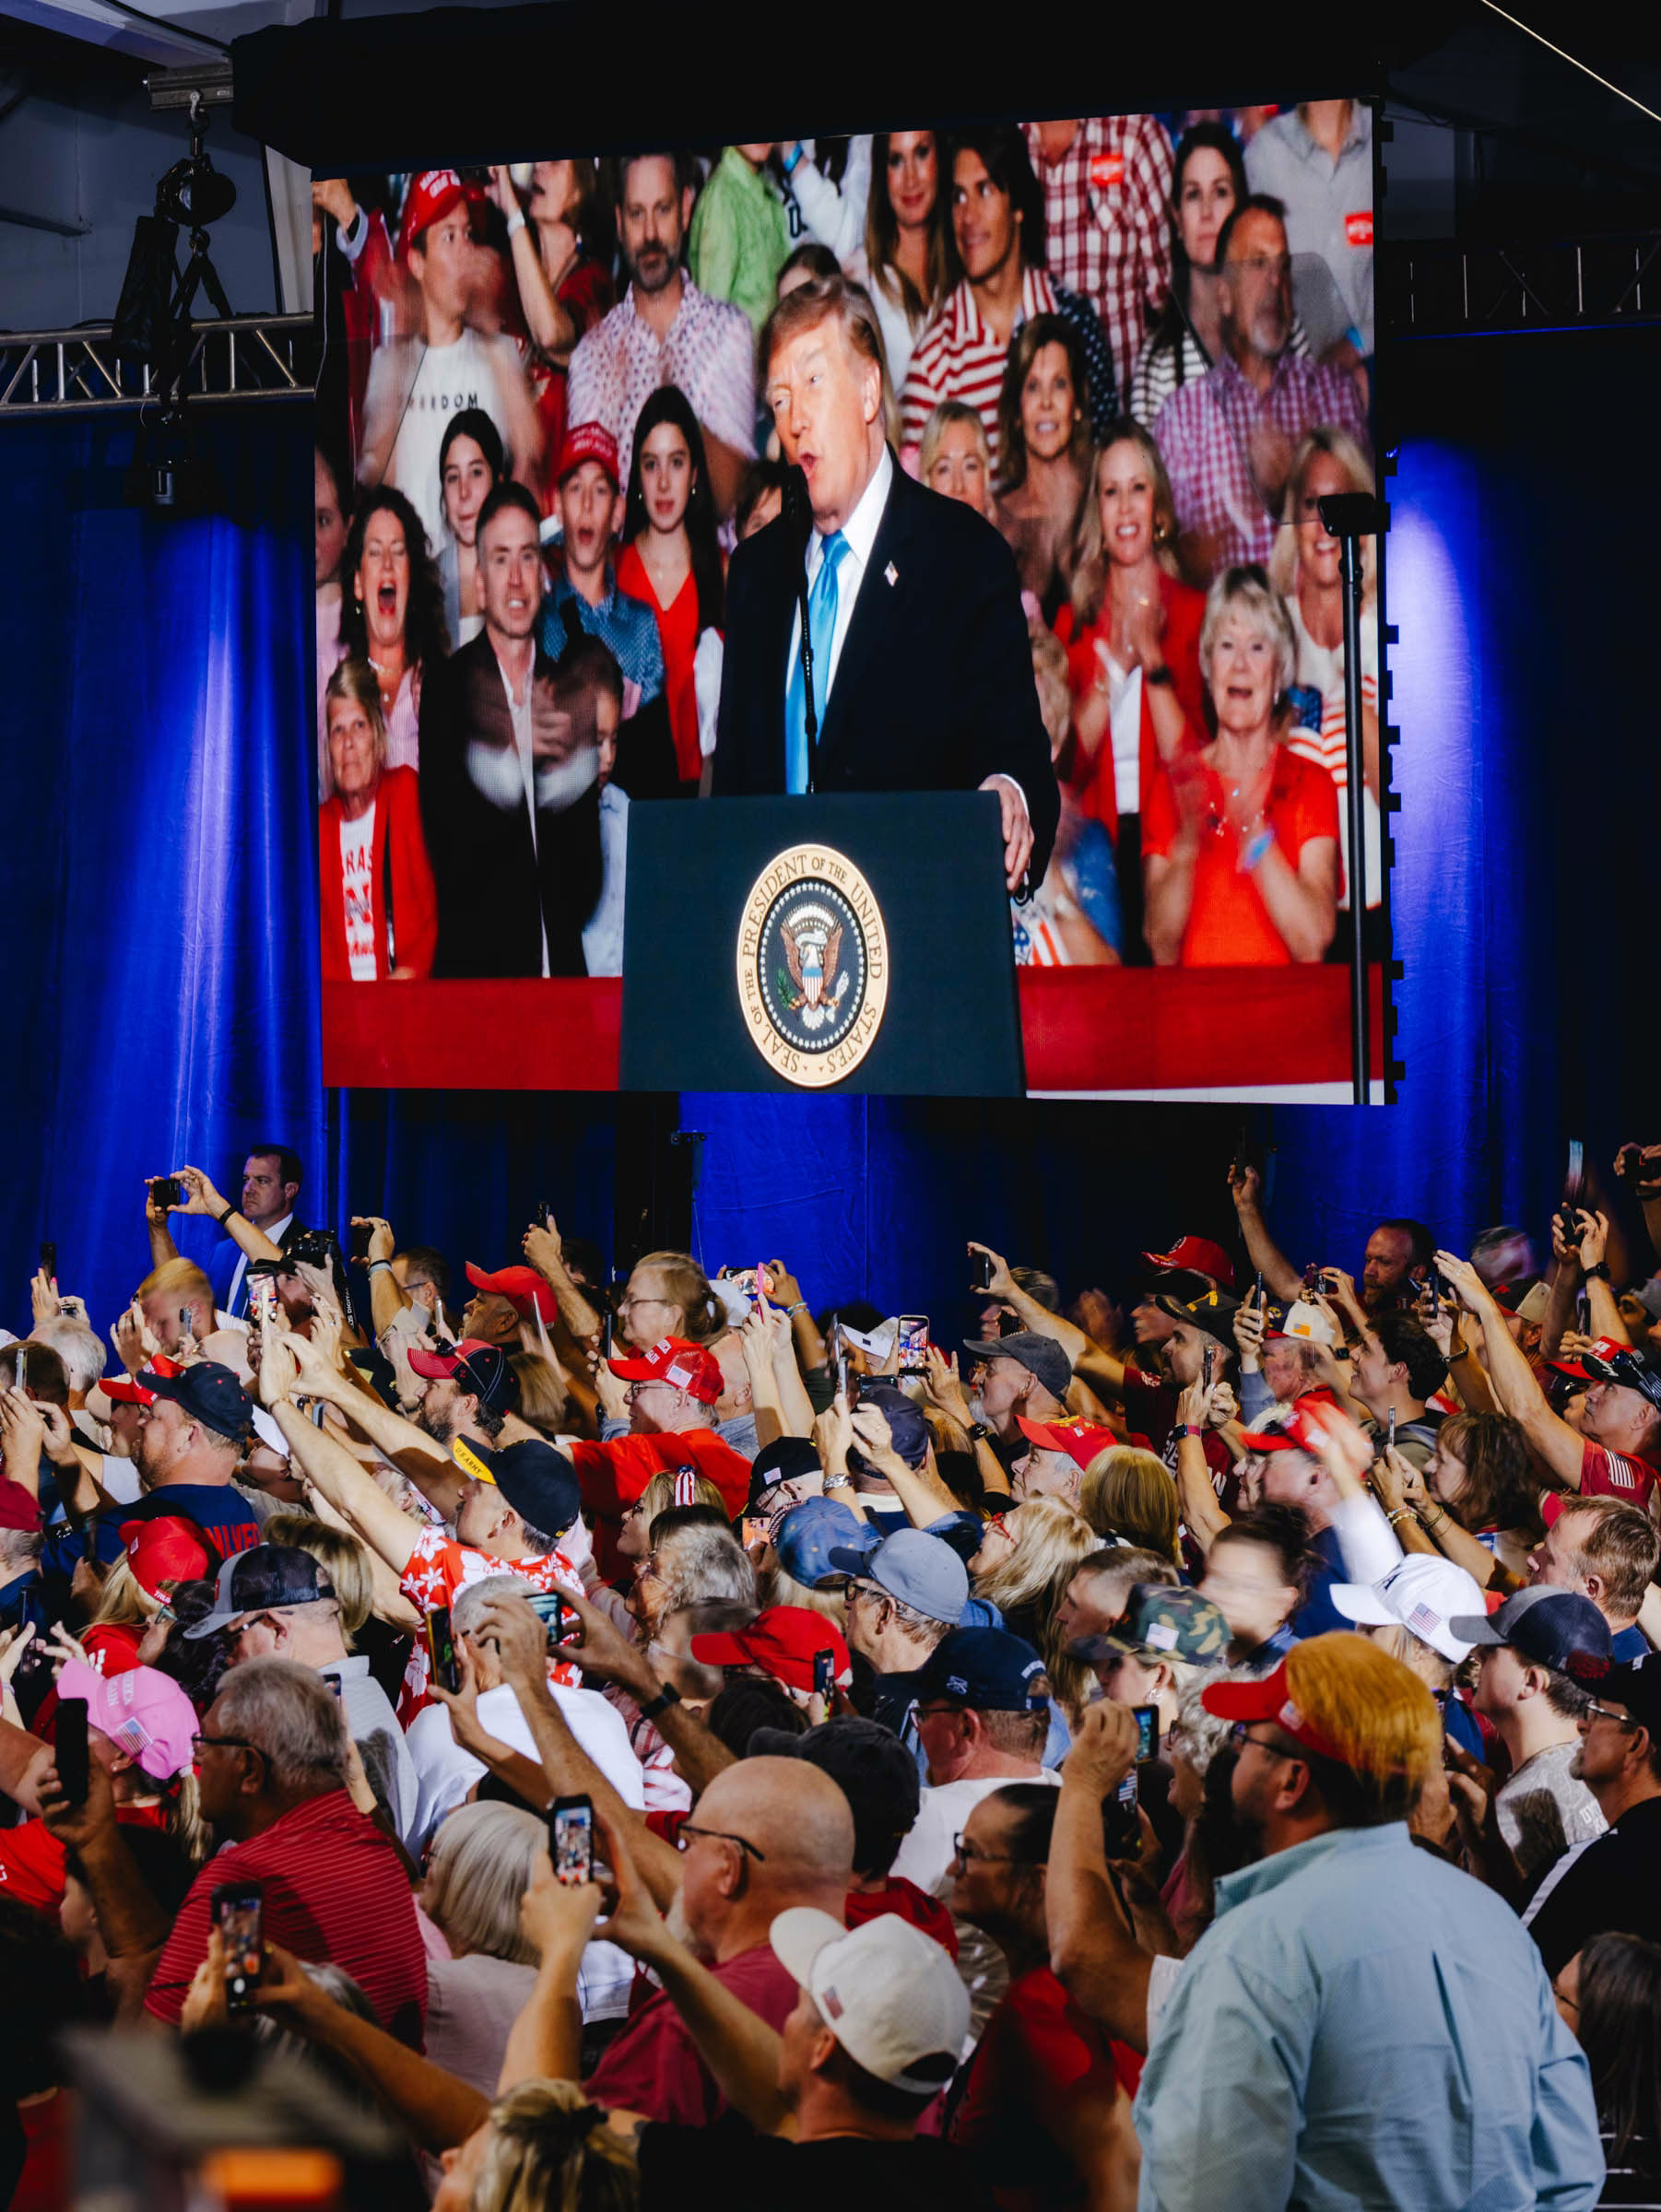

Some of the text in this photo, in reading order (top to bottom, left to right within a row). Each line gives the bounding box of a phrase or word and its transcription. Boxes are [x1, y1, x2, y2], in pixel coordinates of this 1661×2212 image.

[742, 854, 882, 1074] SEAL OF THE PRESIDENT OF THE UNITED STATES
